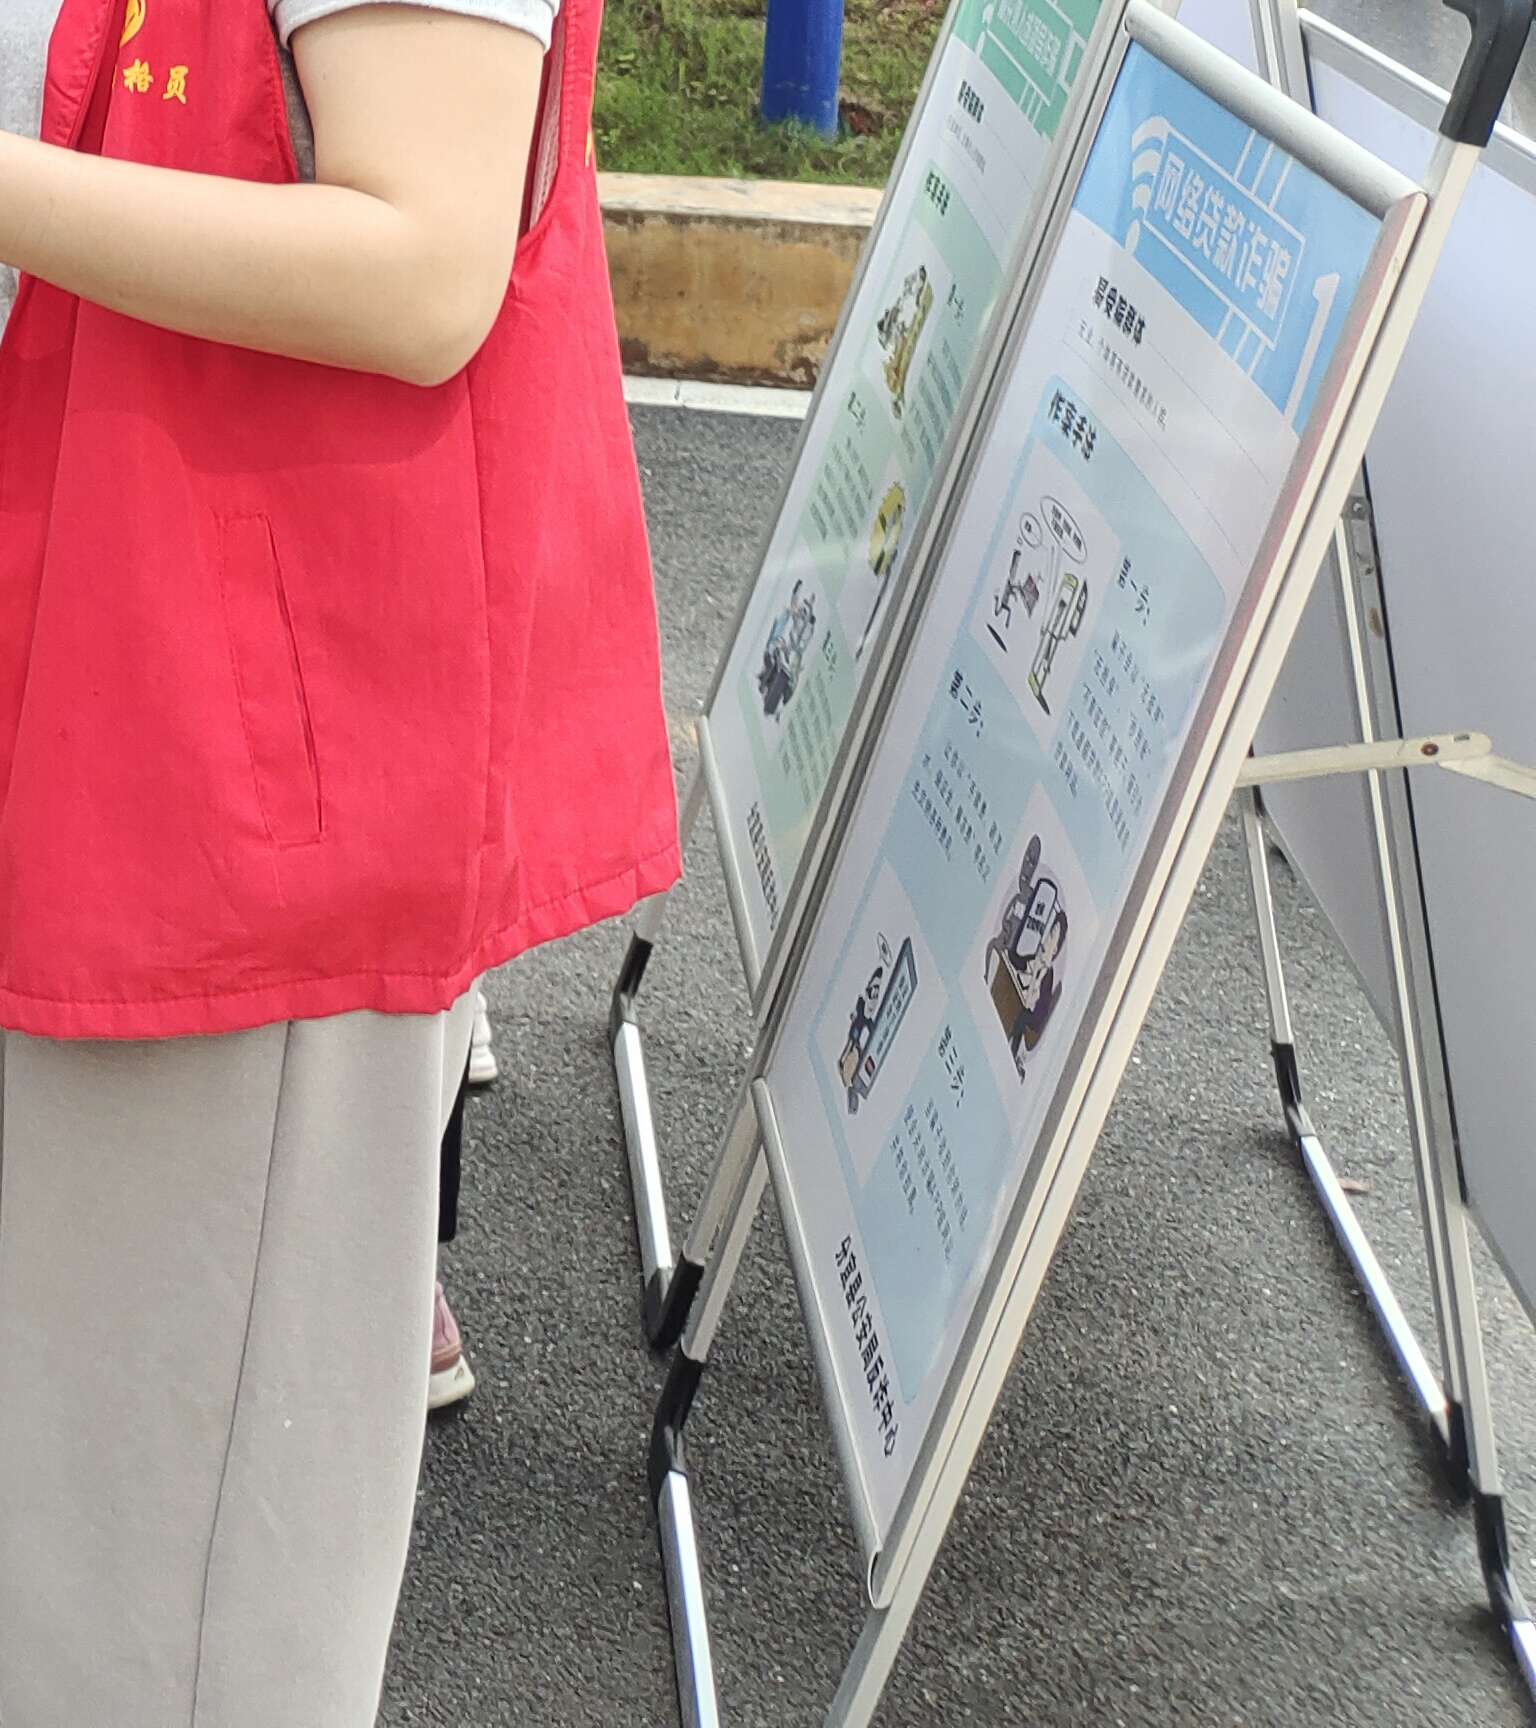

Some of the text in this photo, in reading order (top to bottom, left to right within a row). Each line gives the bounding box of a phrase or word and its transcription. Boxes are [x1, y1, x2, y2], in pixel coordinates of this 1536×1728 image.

[123, 58, 190, 104] 格员
[1047, 388, 1098, 462] 作案手法
[948, 670, 985, 738] 第二步：
[936, 1025, 967, 1109] 第三步：
[834, 1235, 899, 1460] 分宜县公安局反诈中心
